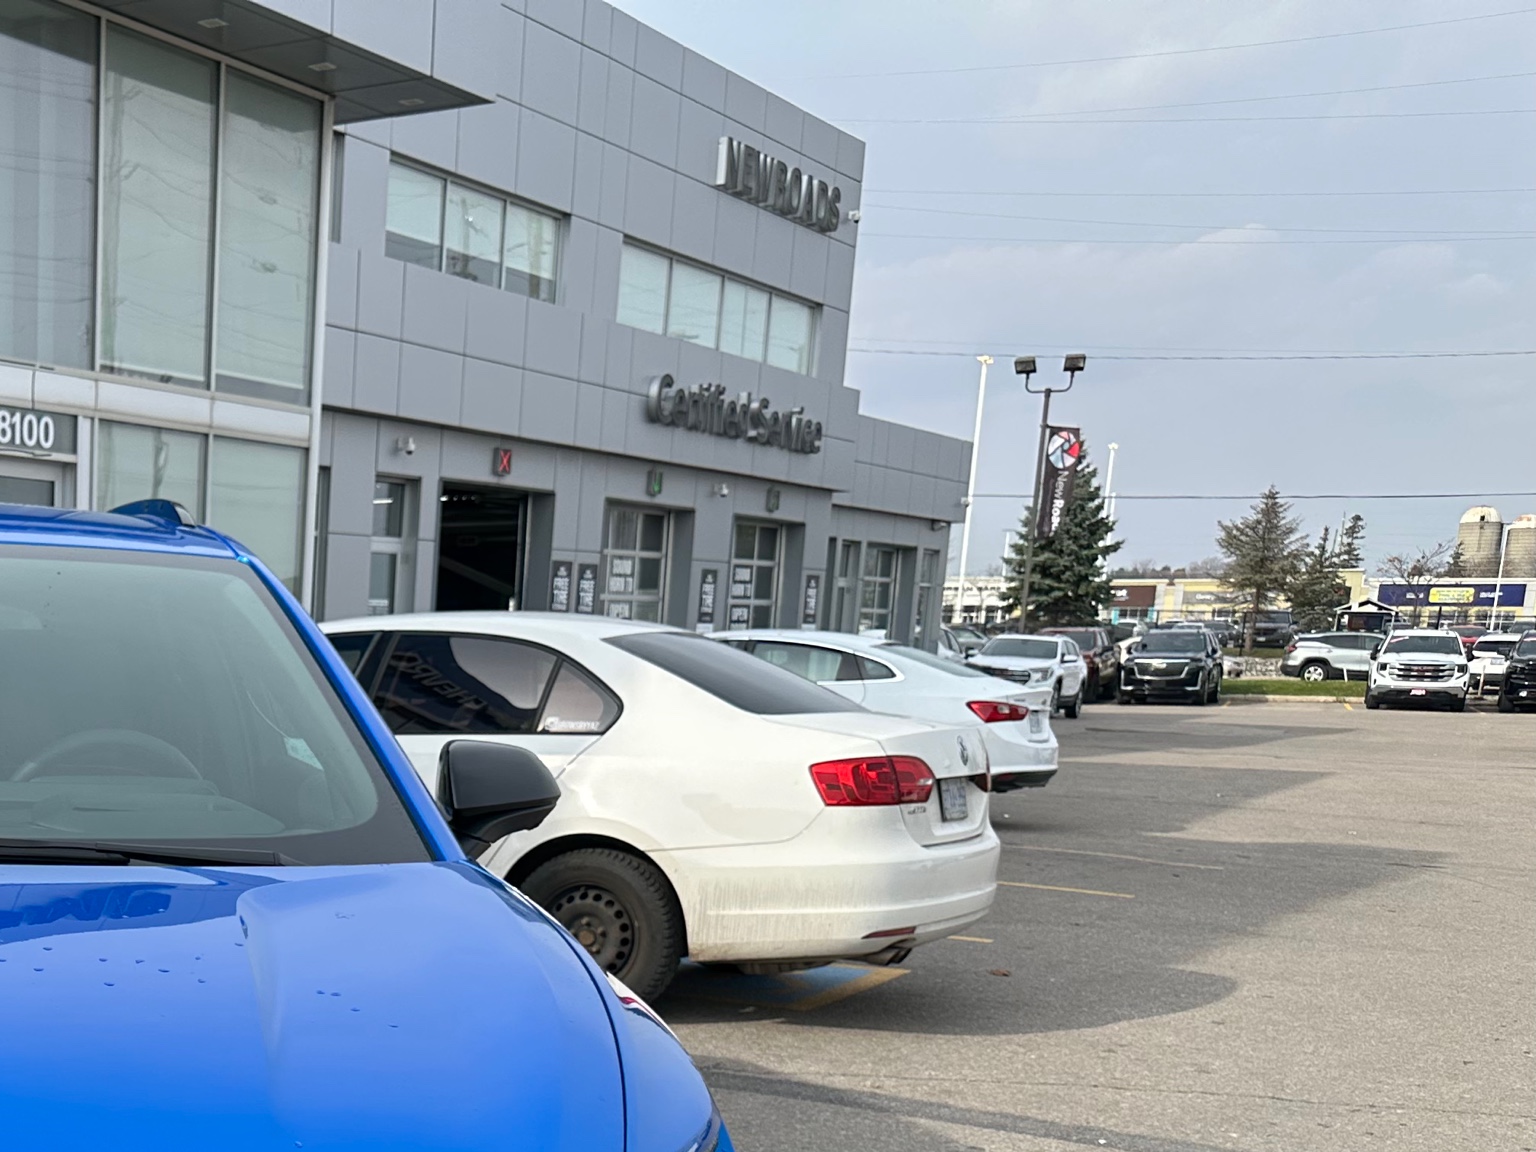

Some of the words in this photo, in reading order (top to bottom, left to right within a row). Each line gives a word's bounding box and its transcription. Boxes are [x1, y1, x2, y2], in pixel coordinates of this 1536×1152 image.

[715, 136, 841, 234] NEWROADS
[647, 373, 751, 439] Certified
[746, 398, 822, 454] Service
